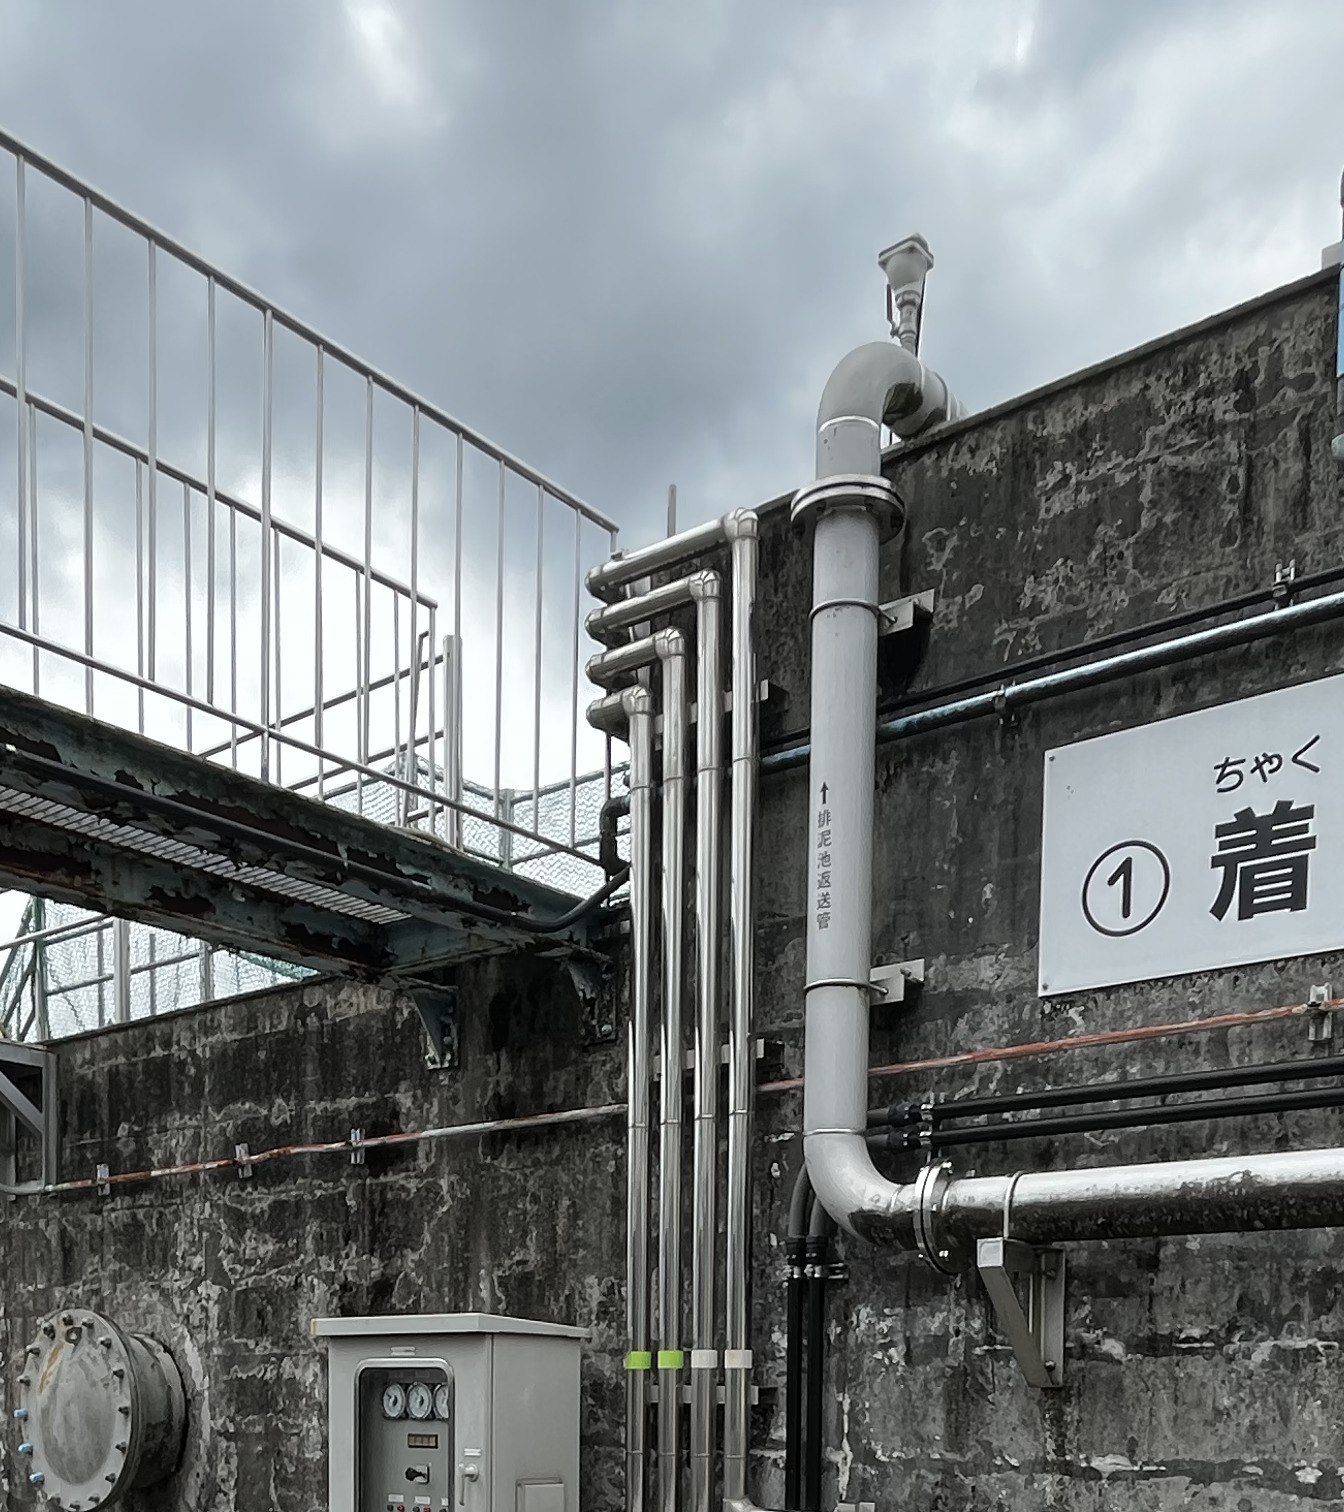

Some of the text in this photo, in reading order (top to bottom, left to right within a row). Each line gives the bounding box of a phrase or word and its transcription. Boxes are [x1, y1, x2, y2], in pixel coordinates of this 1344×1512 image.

[1213, 733, 1322, 795] ちゃく
[816, 808, 832, 931] 排泥池返送管
